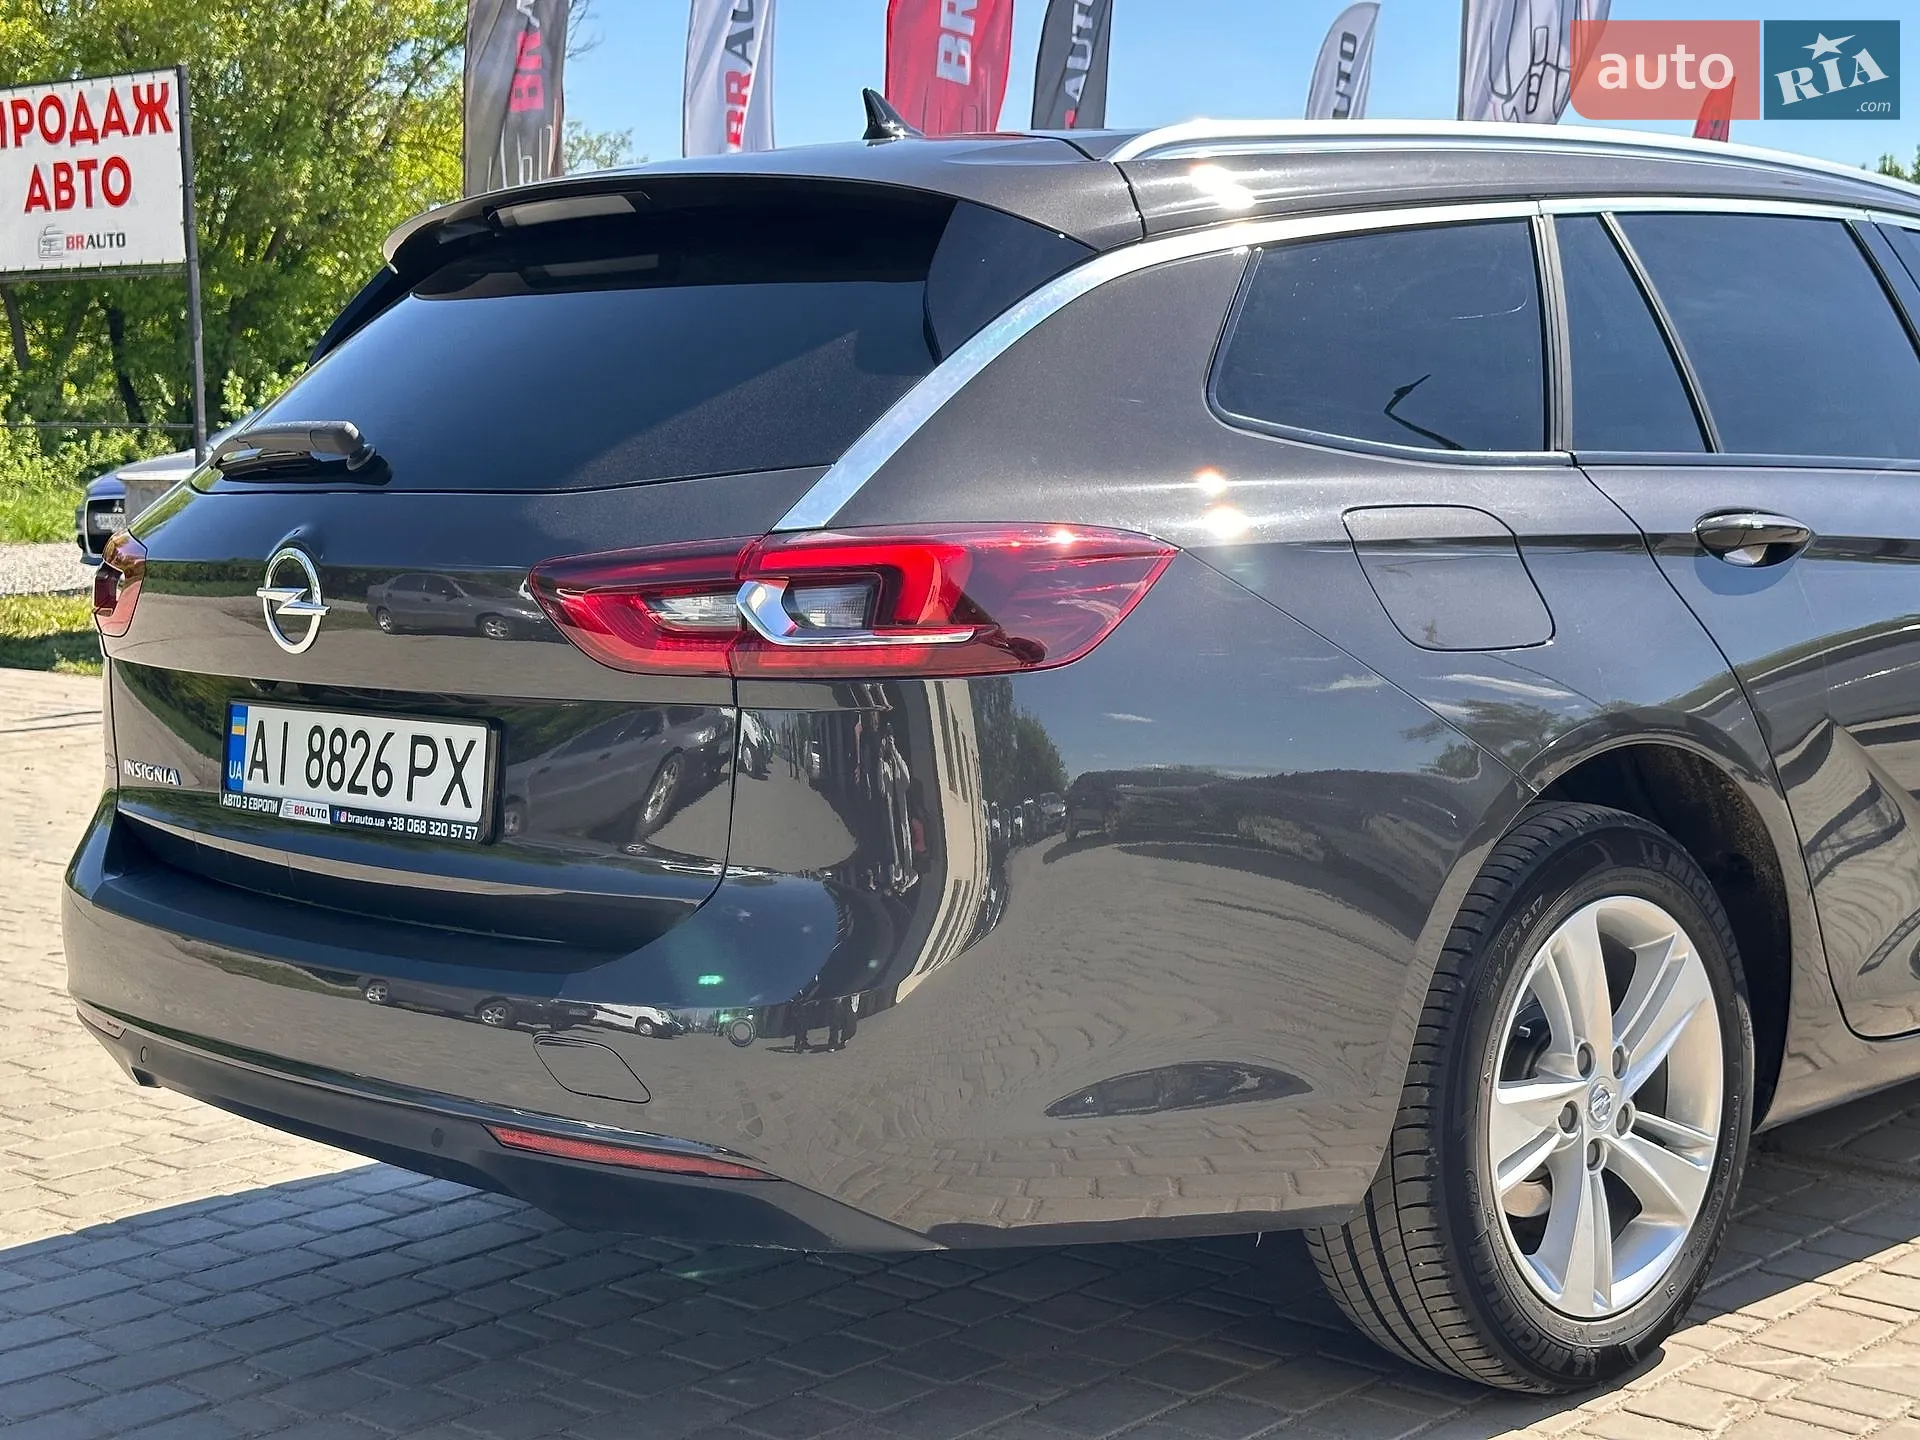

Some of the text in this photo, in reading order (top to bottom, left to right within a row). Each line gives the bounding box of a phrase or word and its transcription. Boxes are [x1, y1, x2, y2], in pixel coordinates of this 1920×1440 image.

[24, 156, 132, 214] АВТО
[66, 232, 126, 250] BRAUTO
[124, 759, 181, 785] INSIGNIA
[228, 760, 243, 780] UA
[247, 720, 476, 808] AI 8826 PX
[223, 793, 241, 808] АВТО
[294, 804, 327, 819] BRAUTO
[348, 812, 385, 827] brauto.ua
[406, 818, 427, 834] 068
[428, 821, 448, 837] 320
[450, 824, 463, 838] 57
[465, 826, 478, 840] 57
